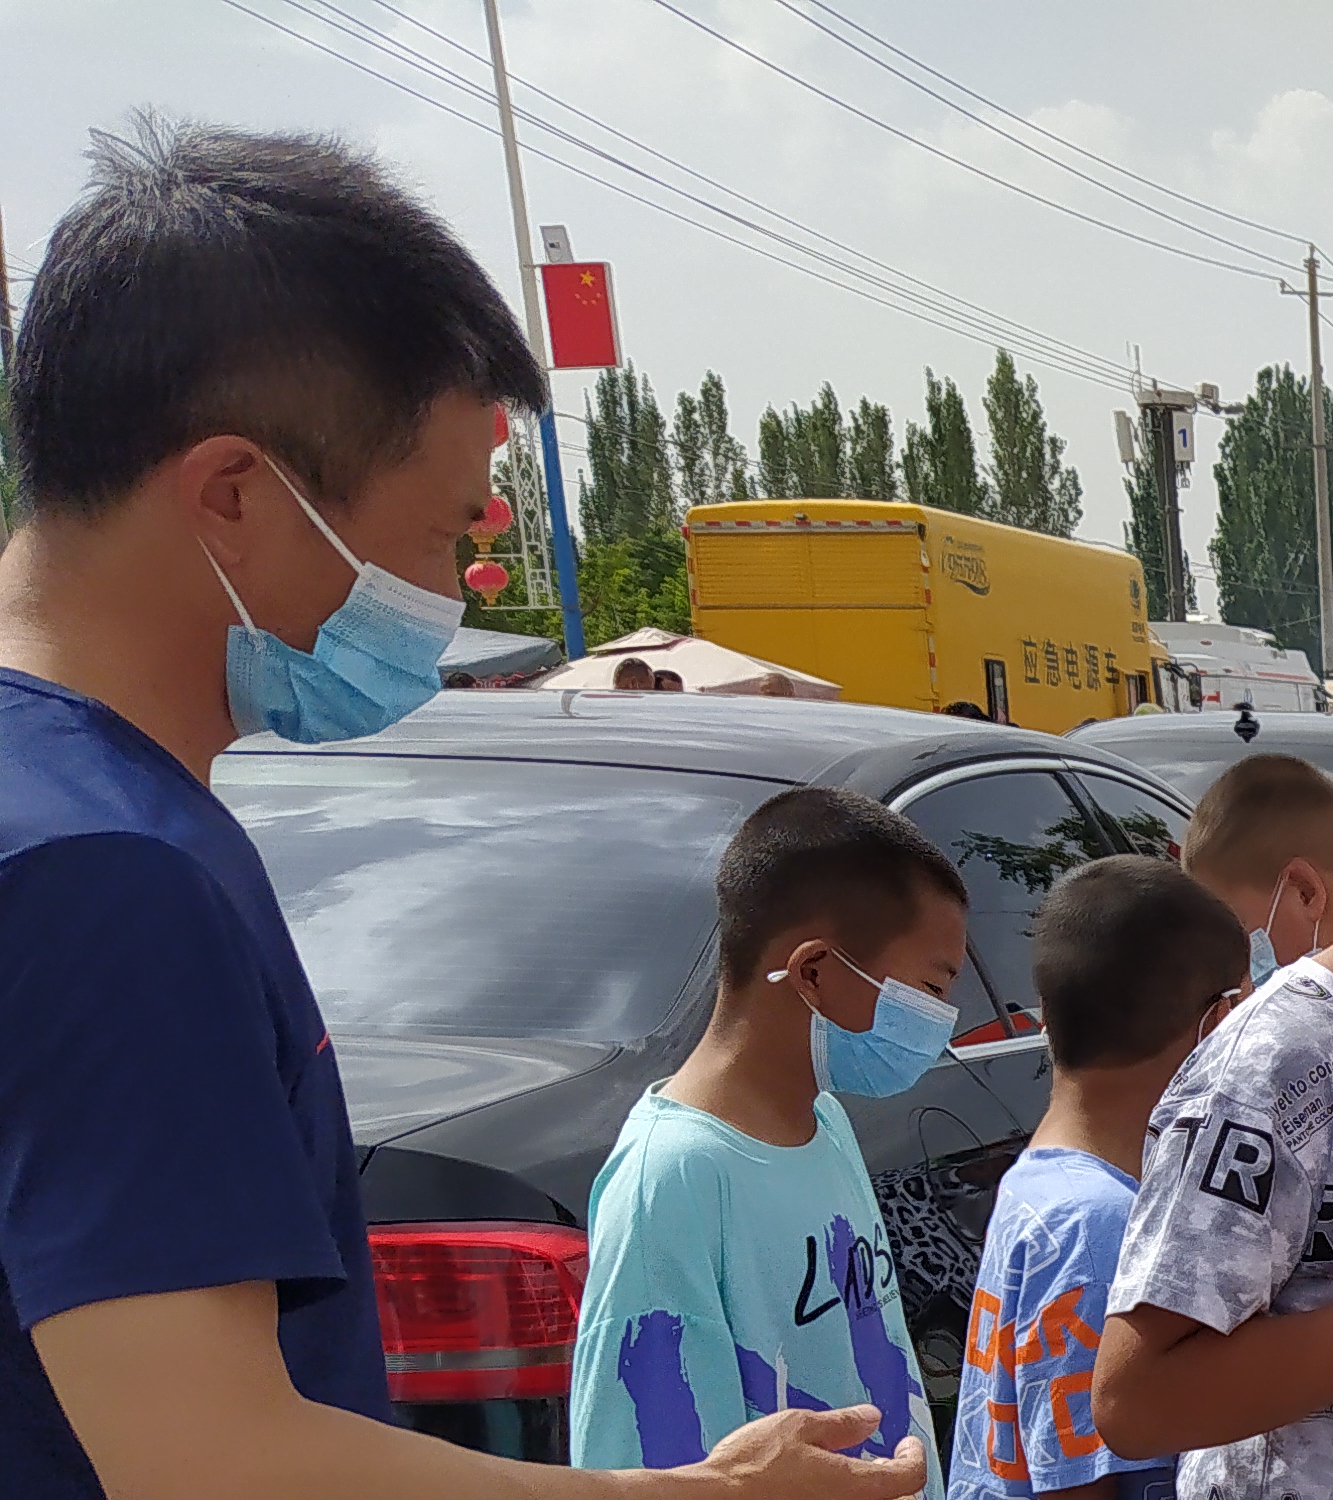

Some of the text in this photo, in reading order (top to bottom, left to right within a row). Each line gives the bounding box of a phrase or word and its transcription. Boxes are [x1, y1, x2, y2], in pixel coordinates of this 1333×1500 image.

[1178, 428, 1187, 448] 1
[1022, 638, 1120, 691] 应急电源车
